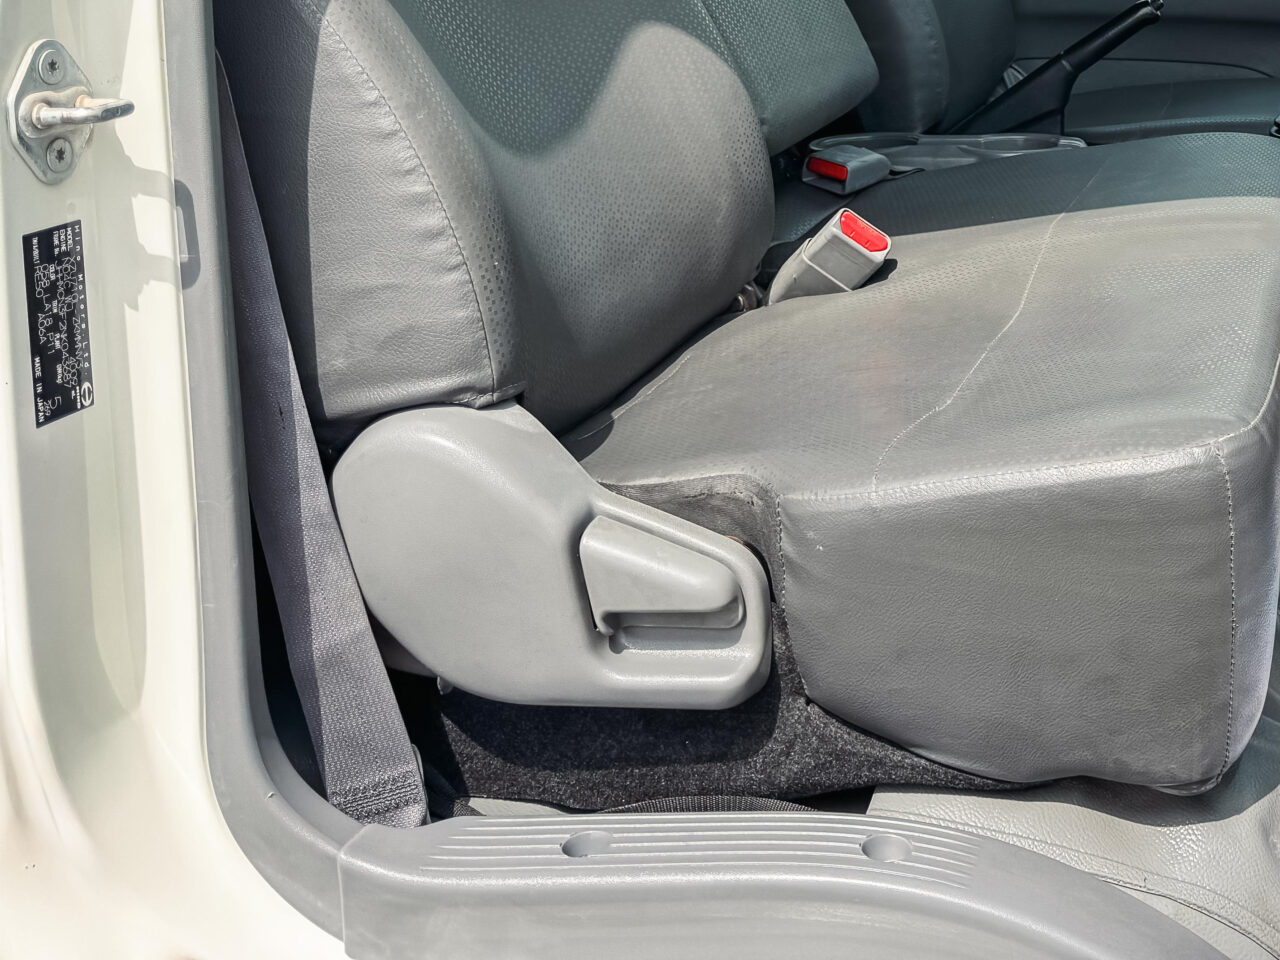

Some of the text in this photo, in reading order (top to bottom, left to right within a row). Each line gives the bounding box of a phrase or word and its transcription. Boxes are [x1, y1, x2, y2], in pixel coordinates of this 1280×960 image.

[74, 224, 82, 261] Hino
[40, 262, 50, 288] 058
[42, 293, 53, 327] LA18
[36, 311, 47, 344] A06A
[68, 354, 78, 387] 4009
[33, 356, 44, 423] MADE IN JAPAN
[48, 394, 62, 410] 5
